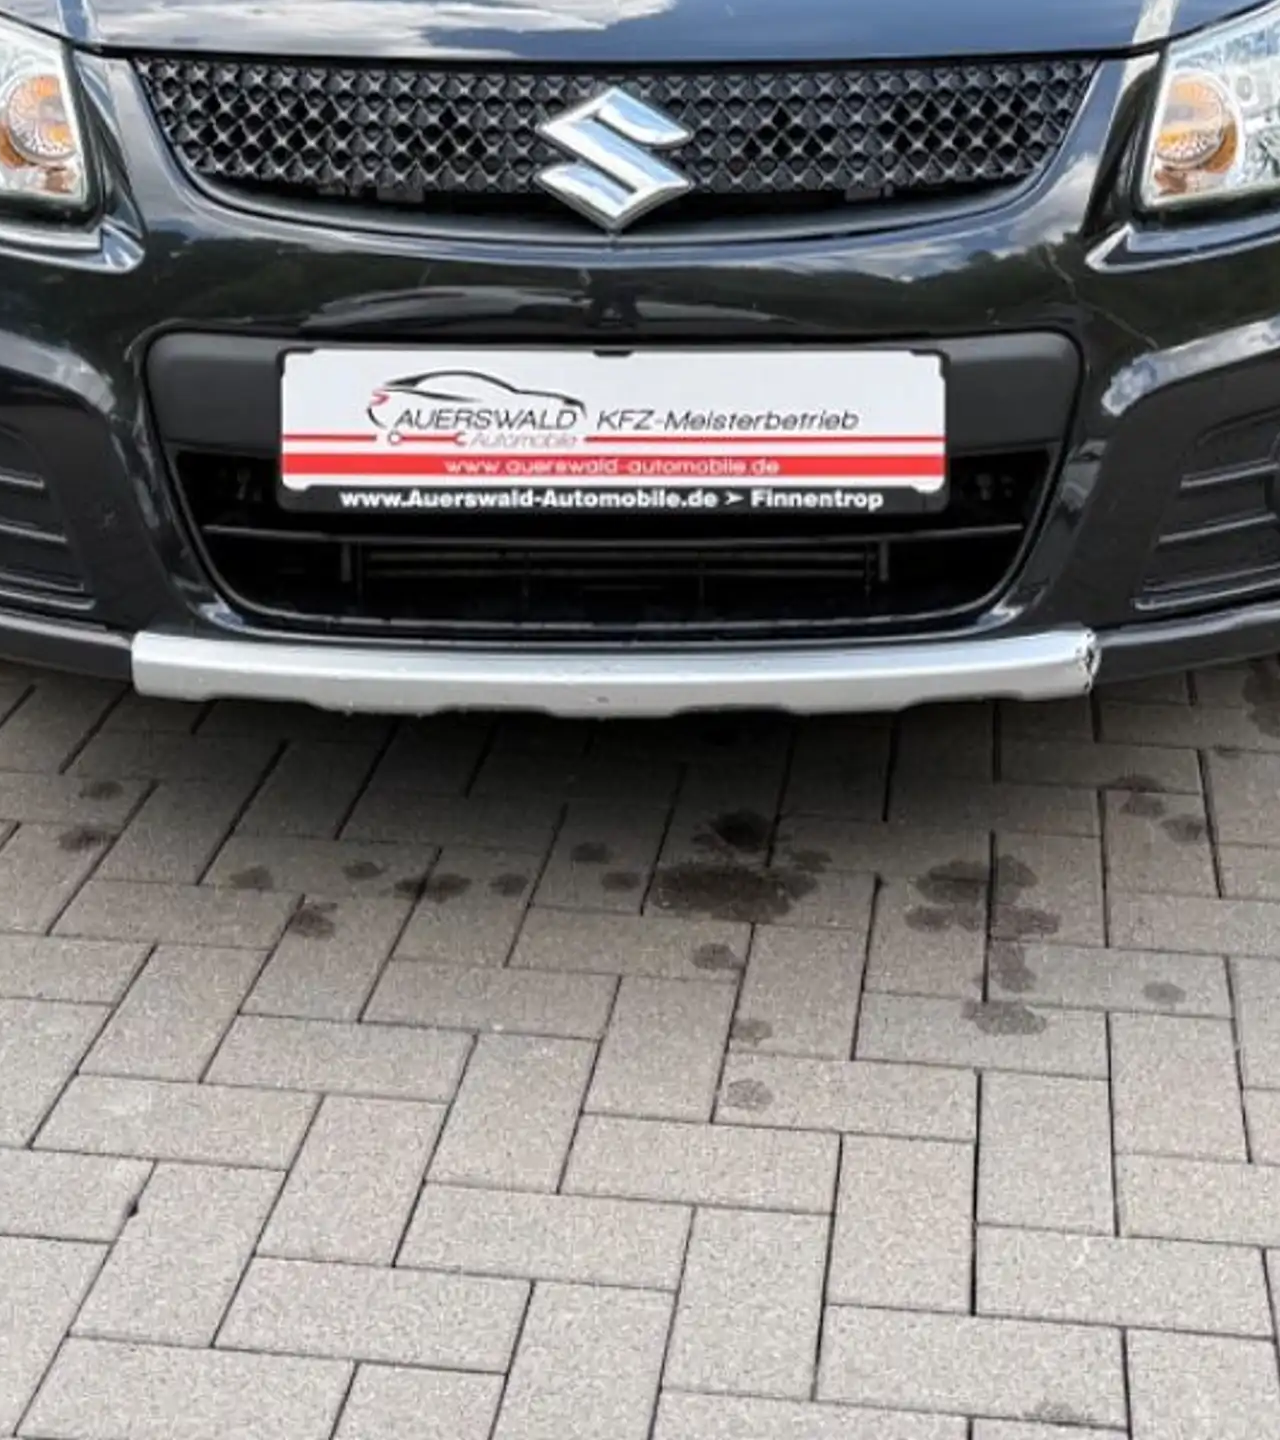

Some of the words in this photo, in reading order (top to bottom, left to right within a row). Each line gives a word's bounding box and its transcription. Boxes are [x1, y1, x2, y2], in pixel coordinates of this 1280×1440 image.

[394, 408, 578, 430] AUERSWALD
[596, 409, 859, 431] KFZ-Meisterbetrieb
[470, 432, 578, 449] Automobile
[444, 458, 780, 476] www.auerswald-automobile.de
[340, 488, 718, 509] www.Auerswald-Automobile.de
[750, 488, 884, 511] Finnentrop
